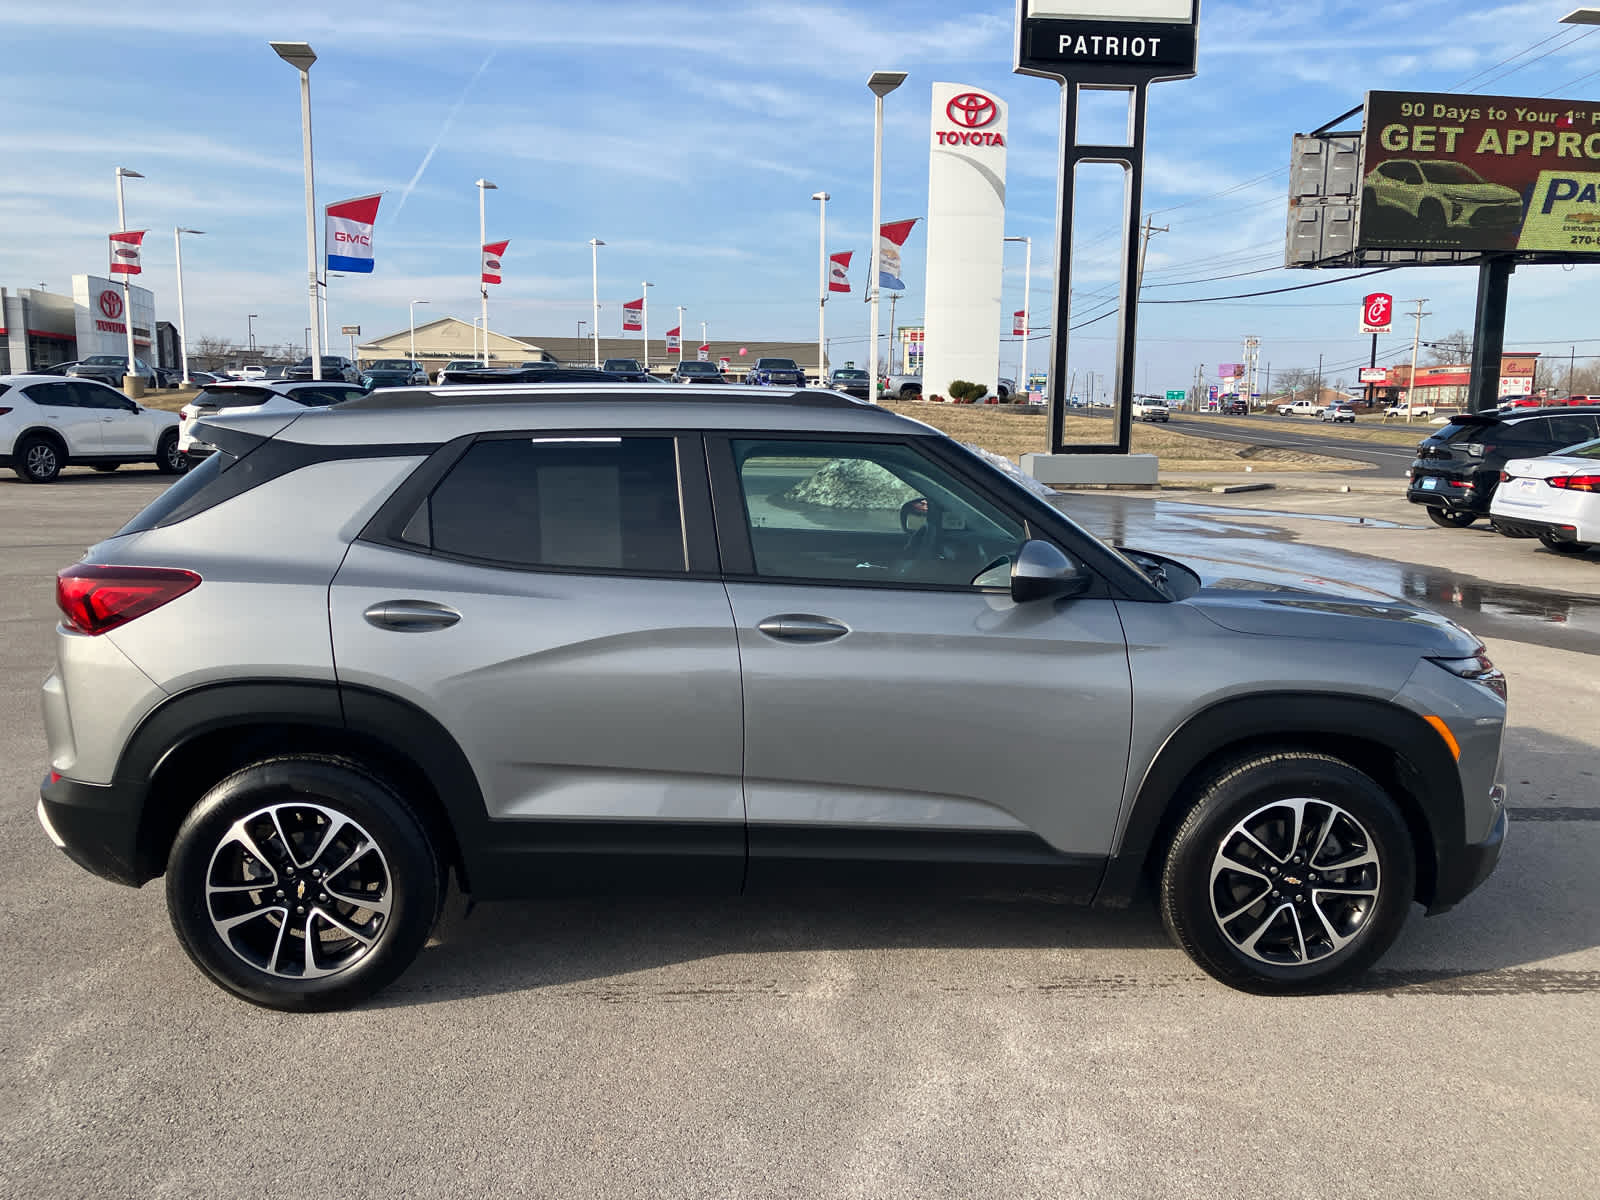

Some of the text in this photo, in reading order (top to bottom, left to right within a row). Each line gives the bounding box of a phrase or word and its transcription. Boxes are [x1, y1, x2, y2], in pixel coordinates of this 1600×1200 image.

[1058, 34, 1161, 57] PATRIOT
[1401, 102, 1425, 117] 90
[1433, 104, 1480, 123] Days
[1488, 106, 1507, 121] to
[1515, 107, 1559, 124] Your
[935, 130, 1004, 146] TOYOTA
[1380, 123, 1465, 153] GET
[1541, 178, 1600, 215] PA
[334, 231, 370, 247] GMC
